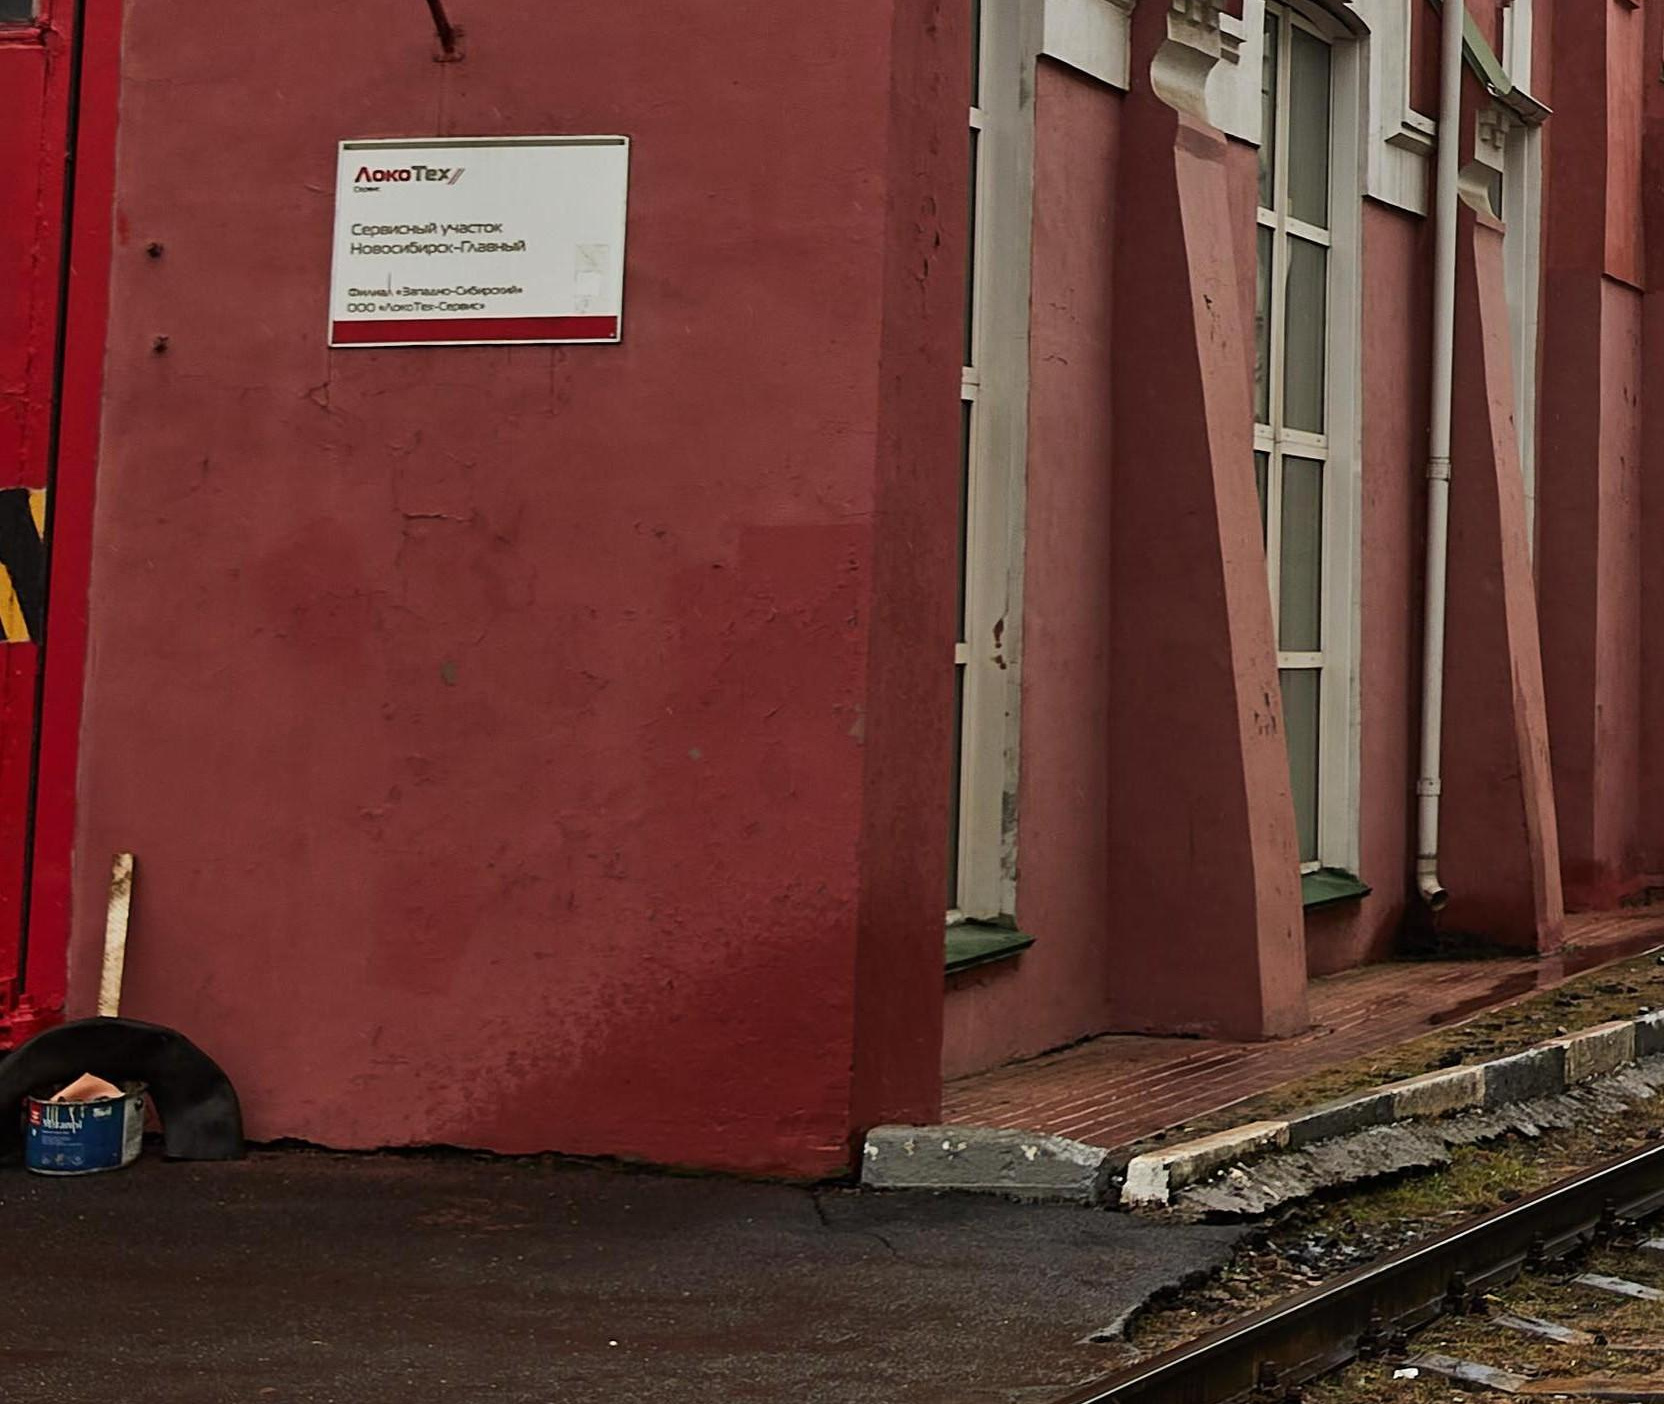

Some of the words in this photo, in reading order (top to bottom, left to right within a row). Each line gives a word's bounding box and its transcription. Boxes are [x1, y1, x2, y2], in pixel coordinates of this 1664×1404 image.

[354, 165, 450, 183] ЛокоТех
[351, 223, 437, 237] Сервисный
[441, 222, 503, 236] участок
[350, 240, 526, 255] Новосибирск-Главный
[347, 303, 376, 312] ООО
